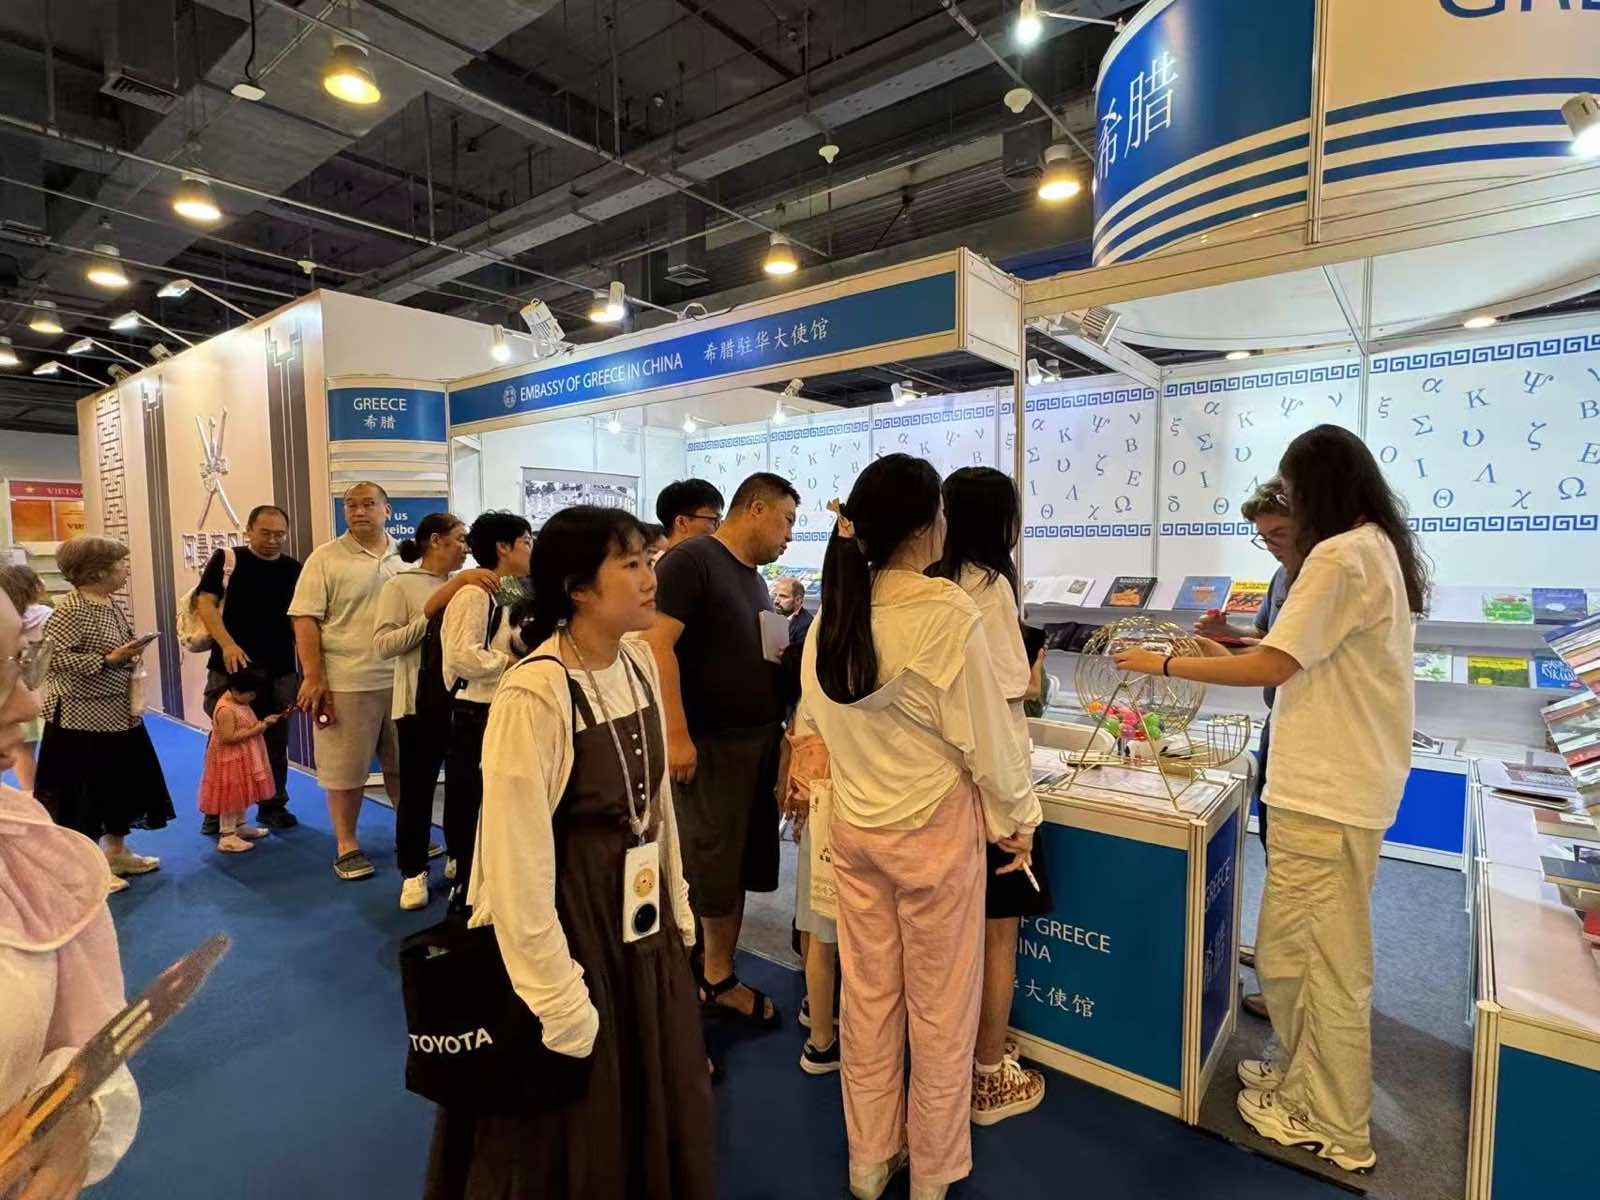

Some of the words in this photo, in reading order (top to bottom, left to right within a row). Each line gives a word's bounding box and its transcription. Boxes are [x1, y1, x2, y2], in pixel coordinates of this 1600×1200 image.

[1096, 50, 1180, 182] 希腊
[703, 317, 830, 362] 希腊驻华大使馆
[519, 378, 565, 402] EMBASSY
[566, 374, 583, 391] OF
[583, 365, 625, 388] GREECE
[626, 362, 639, 382] IN
[641, 353, 683, 377] CHINA
[353, 397, 408, 411] GREECE
[363, 413, 397, 430] 希腊
[1018, 937, 1051, 963] INA
[1035, 917, 1112, 954] GREECE
[1013, 975, 1096, 1018] 大使馆
[408, 1027, 493, 1054] TOYOTA
